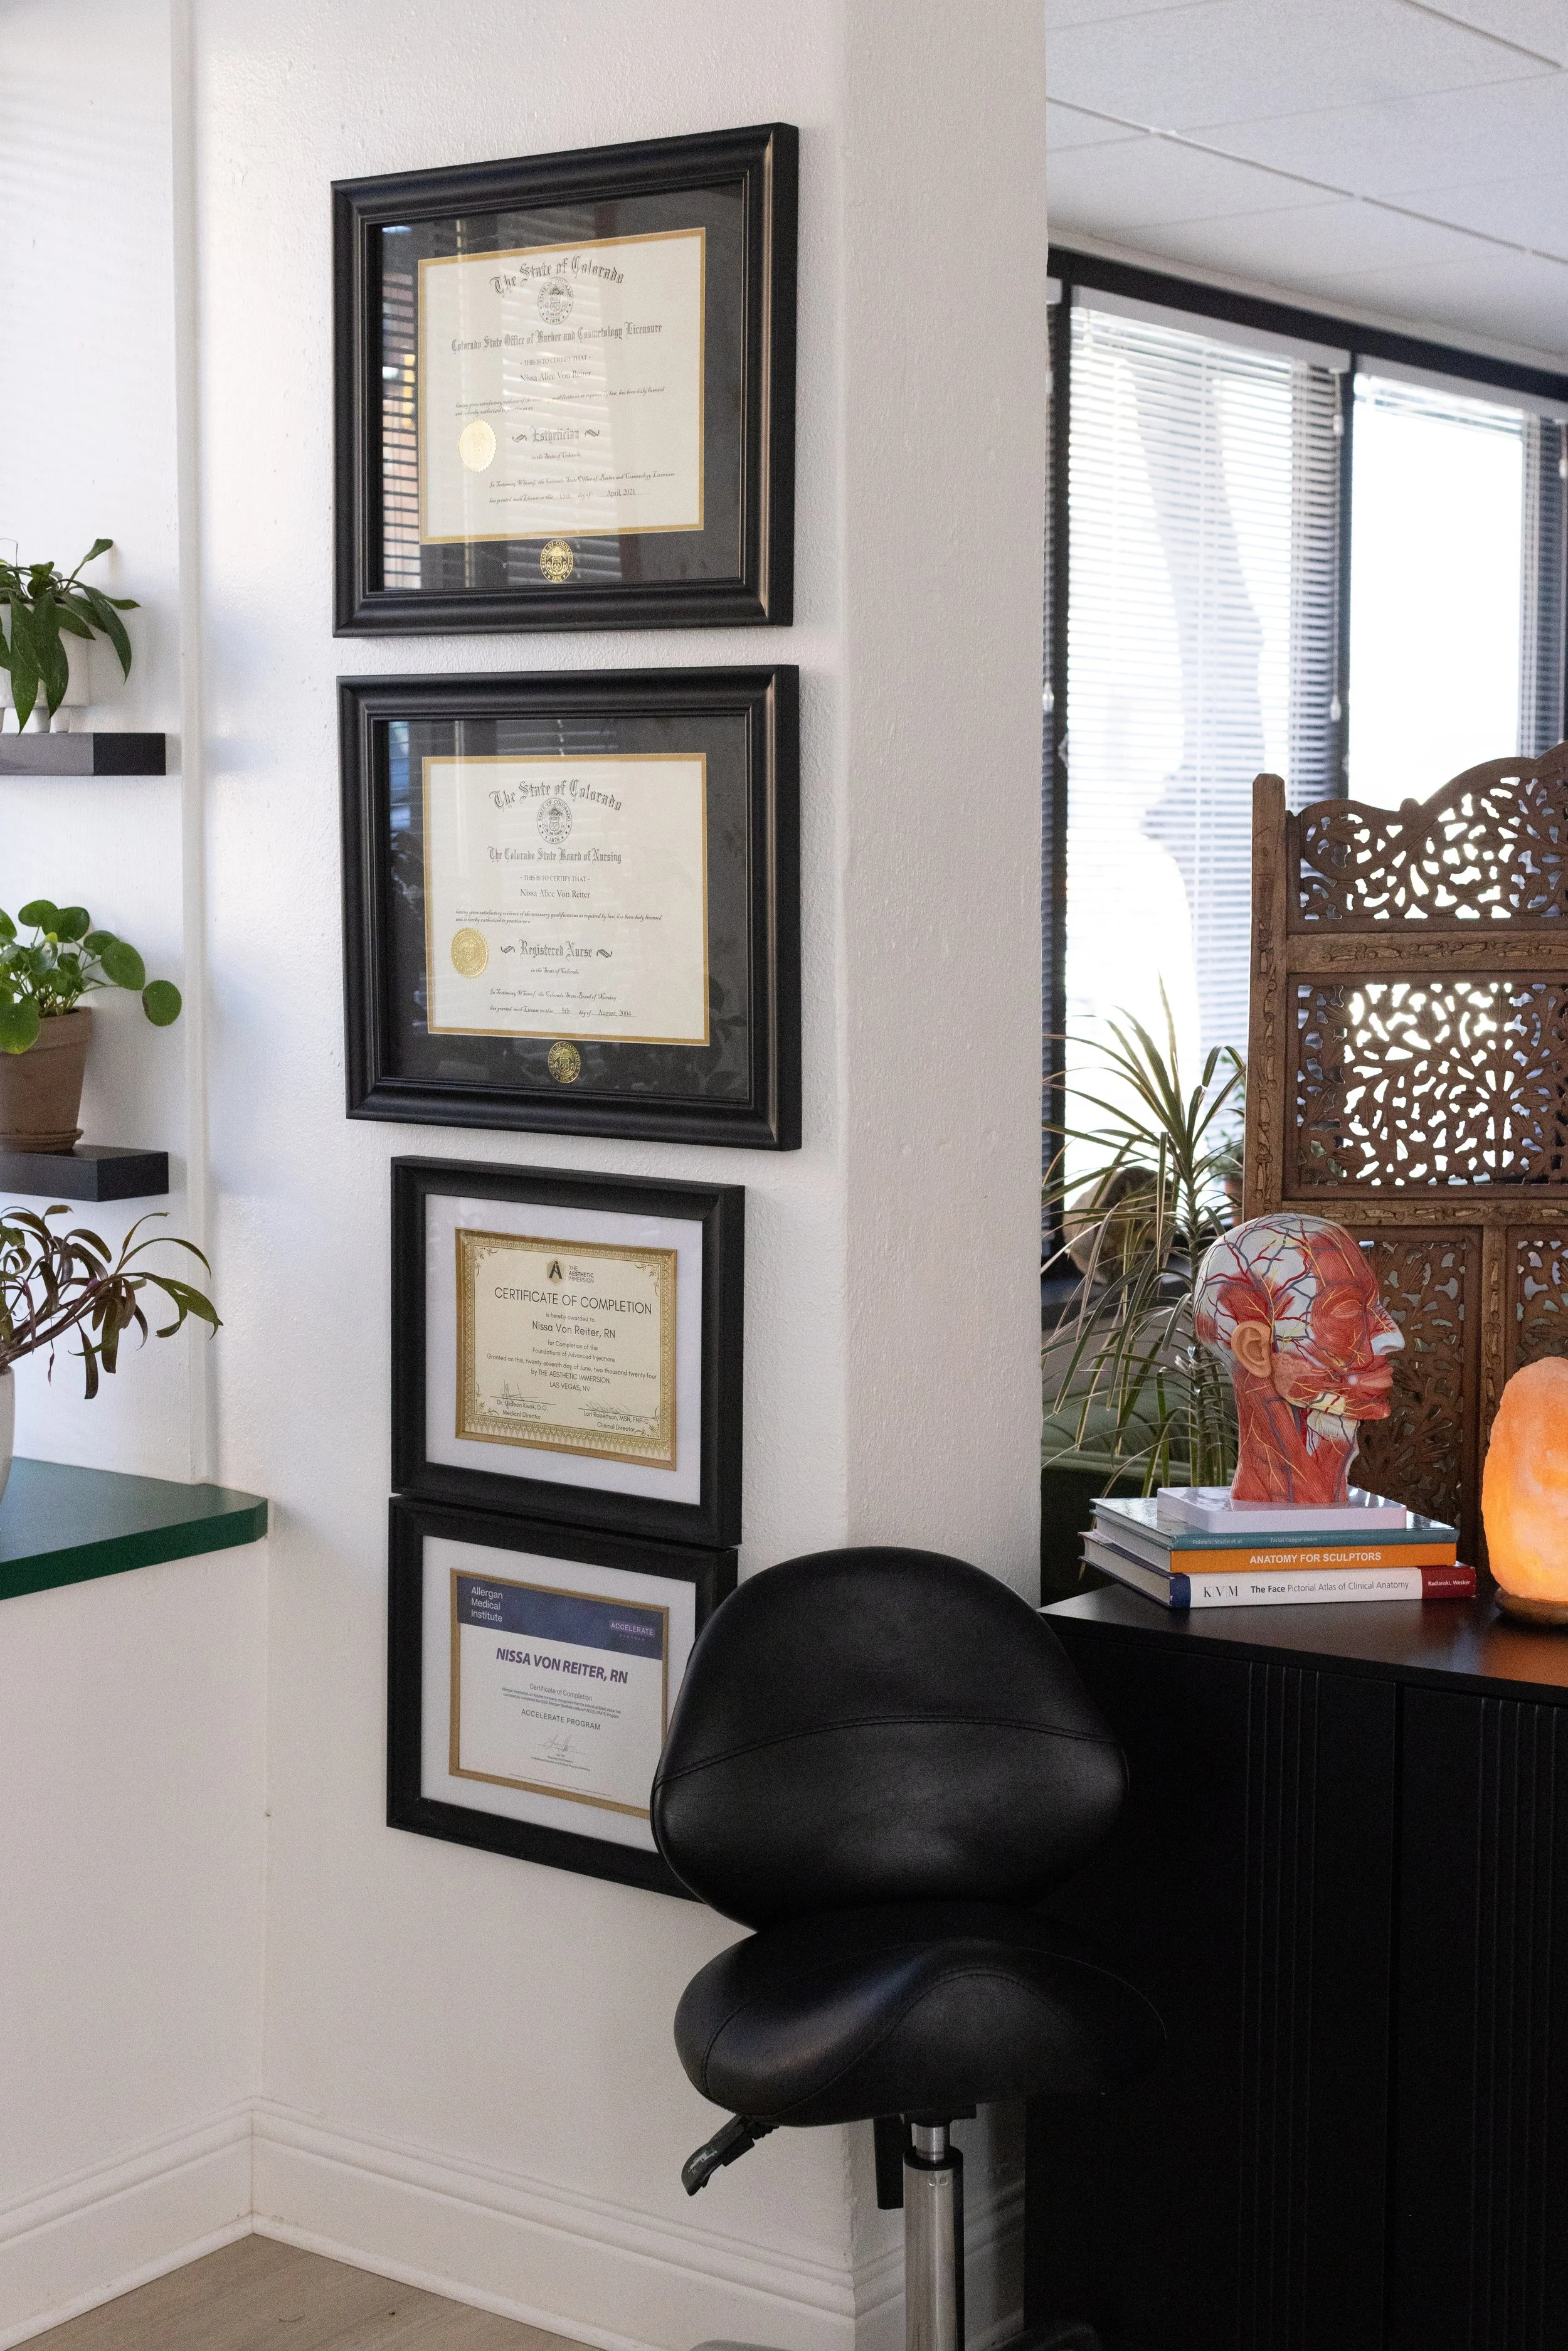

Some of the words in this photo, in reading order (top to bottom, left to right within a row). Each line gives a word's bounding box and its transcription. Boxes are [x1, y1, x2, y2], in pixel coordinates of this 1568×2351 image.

[489, 275, 517, 298] The
[519, 261, 552, 287] State
[555, 257, 568, 275] of
[571, 255, 624, 284] Colorado
[452, 339, 481, 351] Colorado
[484, 336, 502, 348] State
[504, 334, 524, 346] Office
[527, 333, 534, 344] of
[536, 331, 561, 342] Barber
[563, 331, 575, 341] and
[626, 323, 662, 334] Licensure
[607, 489, 622, 497] April,
[489, 790, 516, 812] The
[518, 781, 551, 804] State
[553, 780, 567, 795] of
[569, 778, 622, 811] Colorado
[488, 847, 502, 862] The
[504, 848, 534, 862] Colorado
[537, 847, 556, 862] State
[558, 847, 581, 863] Board
[584, 849, 591, 861] of
[591, 847, 622, 865] Nursing
[519, 939, 563, 958] Registered
[566, 941, 592, 958] Nurse
[494, 1287, 558, 1305] CERTIFICATE
[562, 1294, 577, 1306] OF
[580, 1297, 651, 1314] COMPLETION
[532, 1320, 553, 1331] Nissa
[555, 1323, 571, 1333] Von
[575, 1325, 601, 1338] Reiter,
[604, 1328, 615, 1338] RN
[555, 1340, 582, 1349] Completion
[532, 1347, 561, 1356] Foundations
[526, 1359, 562, 1367] twenty-seventh
[604, 1367, 627, 1376] thousand
[549, 1371, 577, 1379] AESTHETIC
[579, 1375, 610, 1383] IMMERSION
[561, 1383, 581, 1391] VEGAS,
[522, 1411, 541, 1420] Director
[593, 1411, 618, 1421] Robertson,
[616, 1425, 635, 1433] Director
[1250, 1554, 1297, 1563] ANATOMY
[1300, 1554, 1320, 1562] FOR
[1323, 1552, 1381, 1562] SCULPTORS
[471, 1586, 502, 1600] Allergan
[1251, 1585, 1265, 1593] The
[472, 1598, 500, 1610] Medical
[471, 1610, 502, 1622] Institute
[611, 1622, 652, 1635] ACCELERATE
[496, 1648, 530, 1665] NISSA
[534, 1655, 560, 1670] VON
[563, 1660, 607, 1681] REITER,
[610, 1669, 628, 1684] RN
[529, 1683, 556, 1694] Certificate
[563, 1689, 592, 1701] Completion
[521, 1709, 564, 1722] ACCELERATE
[566, 1717, 600, 1729] PROGRAM
